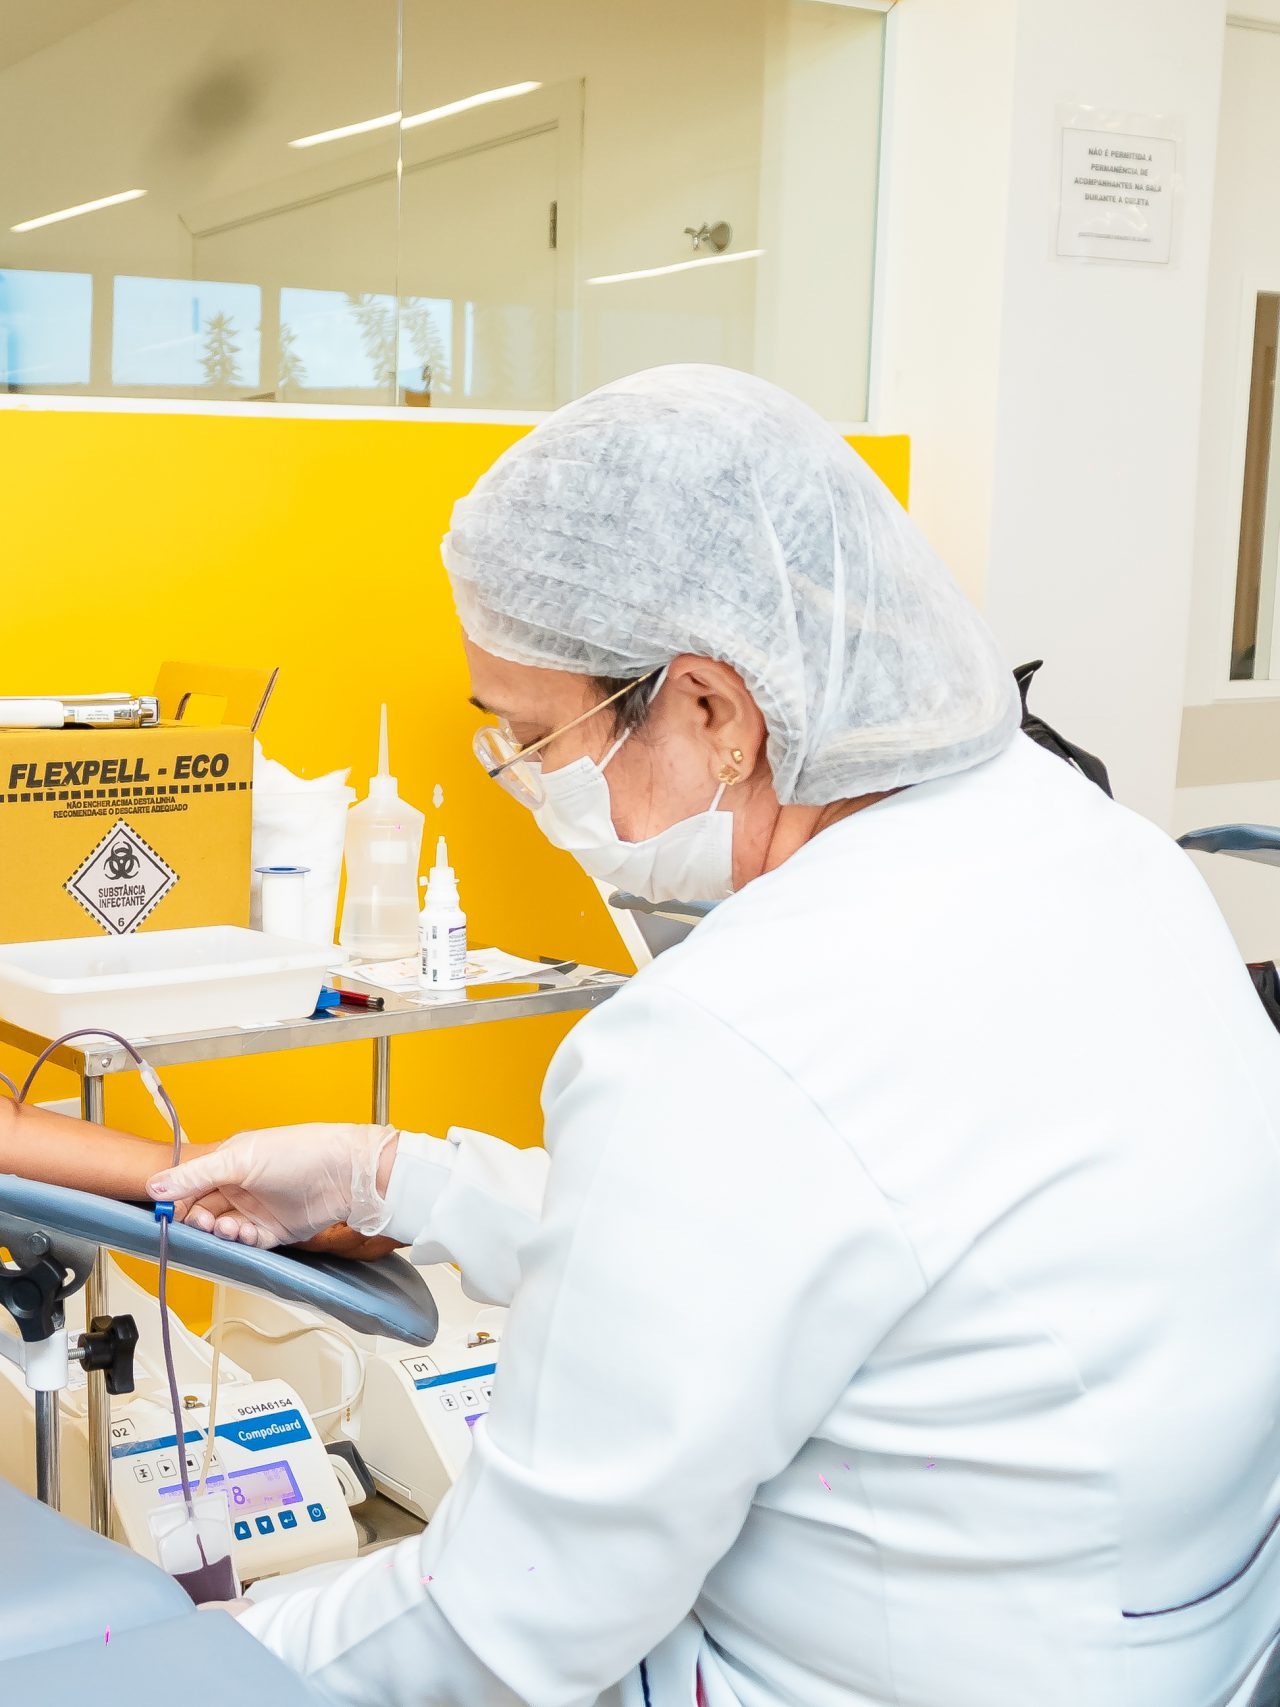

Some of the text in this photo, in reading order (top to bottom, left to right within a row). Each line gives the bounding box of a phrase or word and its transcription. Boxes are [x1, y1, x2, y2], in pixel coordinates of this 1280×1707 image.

[1088, 147, 1103, 157] NÃO
[1110, 150, 1147, 161] PERMITIDA
[1090, 163, 1149, 177] PERMANÊNCIA DE
[1074, 177, 1133, 190] ACOMPANHANTES
[1134, 183, 1145, 191] NA
[1084, 192, 1150, 206] DURANTE A COLETA
[8, 757, 150, 790] FLEXPELL
[173, 753, 230, 780] ECO
[66, 796, 176, 809] NÃO ENCHER ACIMA DESTA LINHA
[53, 803, 188, 819] RECOMENDA-SE O DESCARTE ADEQUADO
[98, 884, 146, 898] SUBSTÂNCIA
[99, 895, 145, 909] INFECTANTE
[117, 917, 125, 927] 6
[413, 1362, 429, 1373] 01
[111, 1427, 131, 1438] 02
[237, 1418, 302, 1442] CompoGuard
